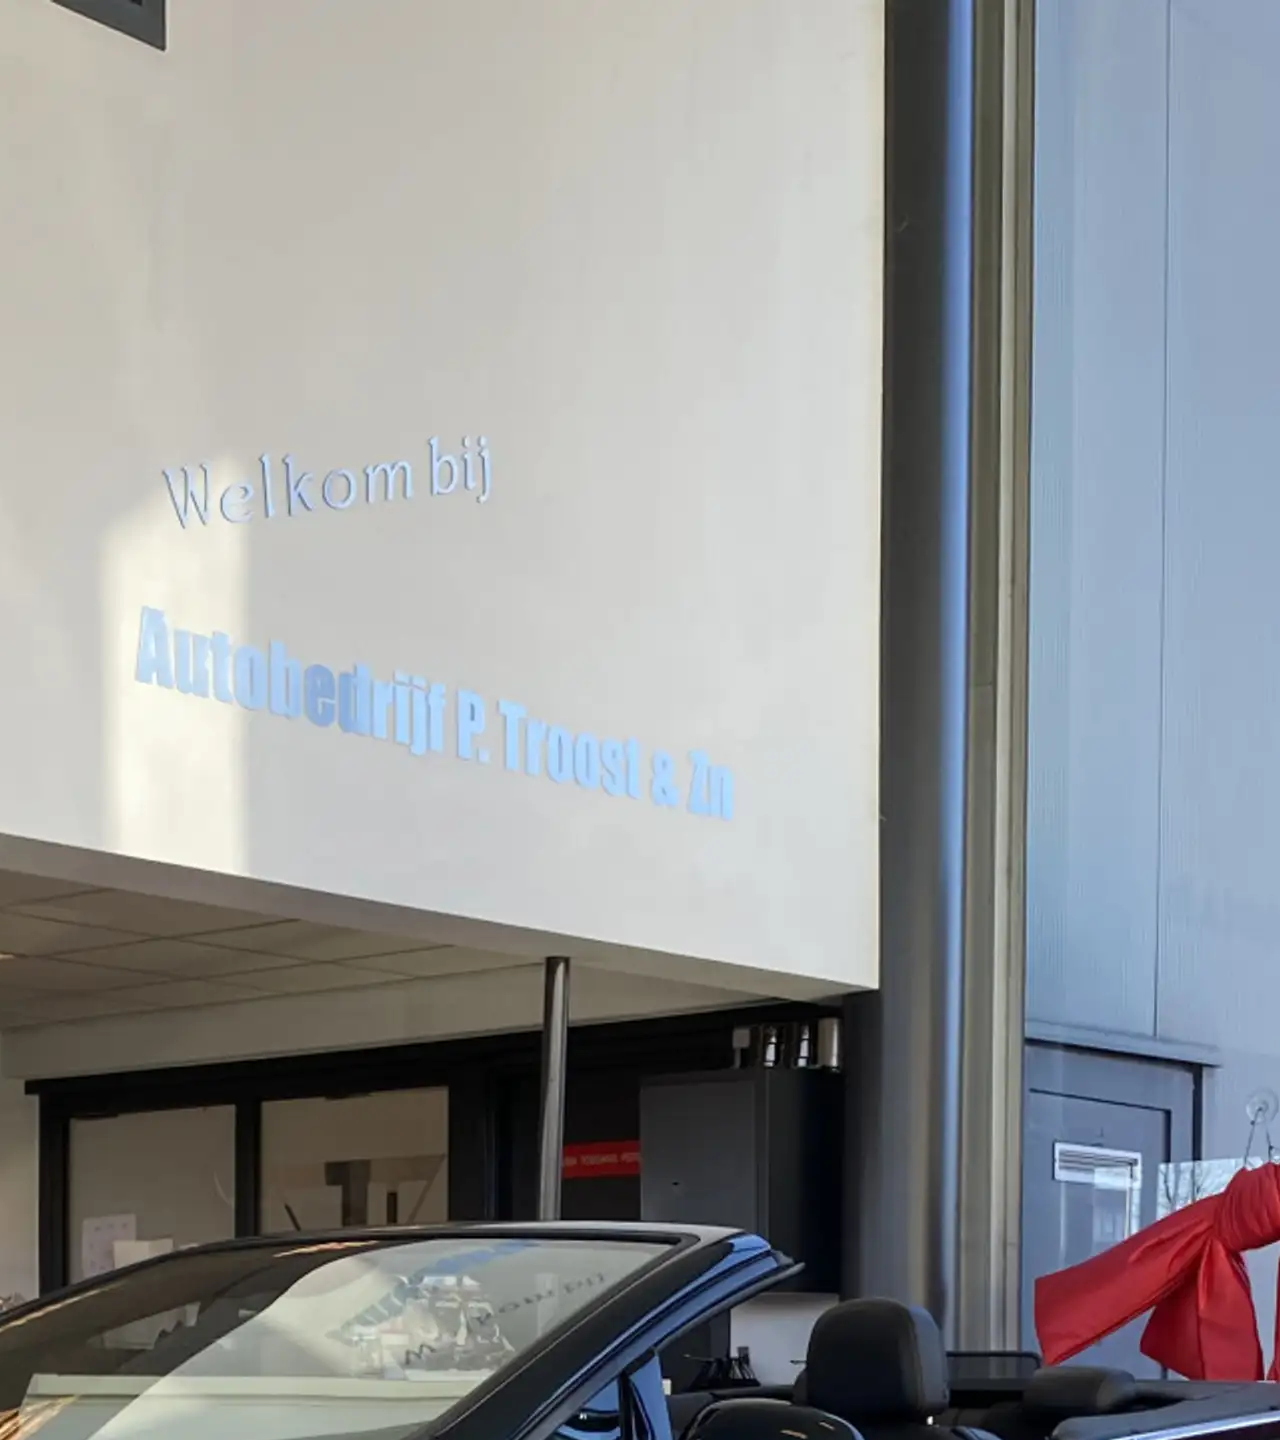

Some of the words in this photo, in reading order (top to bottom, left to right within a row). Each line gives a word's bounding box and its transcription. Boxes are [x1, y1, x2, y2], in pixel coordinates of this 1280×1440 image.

[162, 453, 414, 529] Welkom
[427, 436, 493, 502] bij
[135, 605, 447, 755] Autobedrijf
[456, 689, 490, 763] P.
[499, 700, 643, 799] Troost
[650, 750, 680, 808] &
[687, 750, 734, 820] Zn
